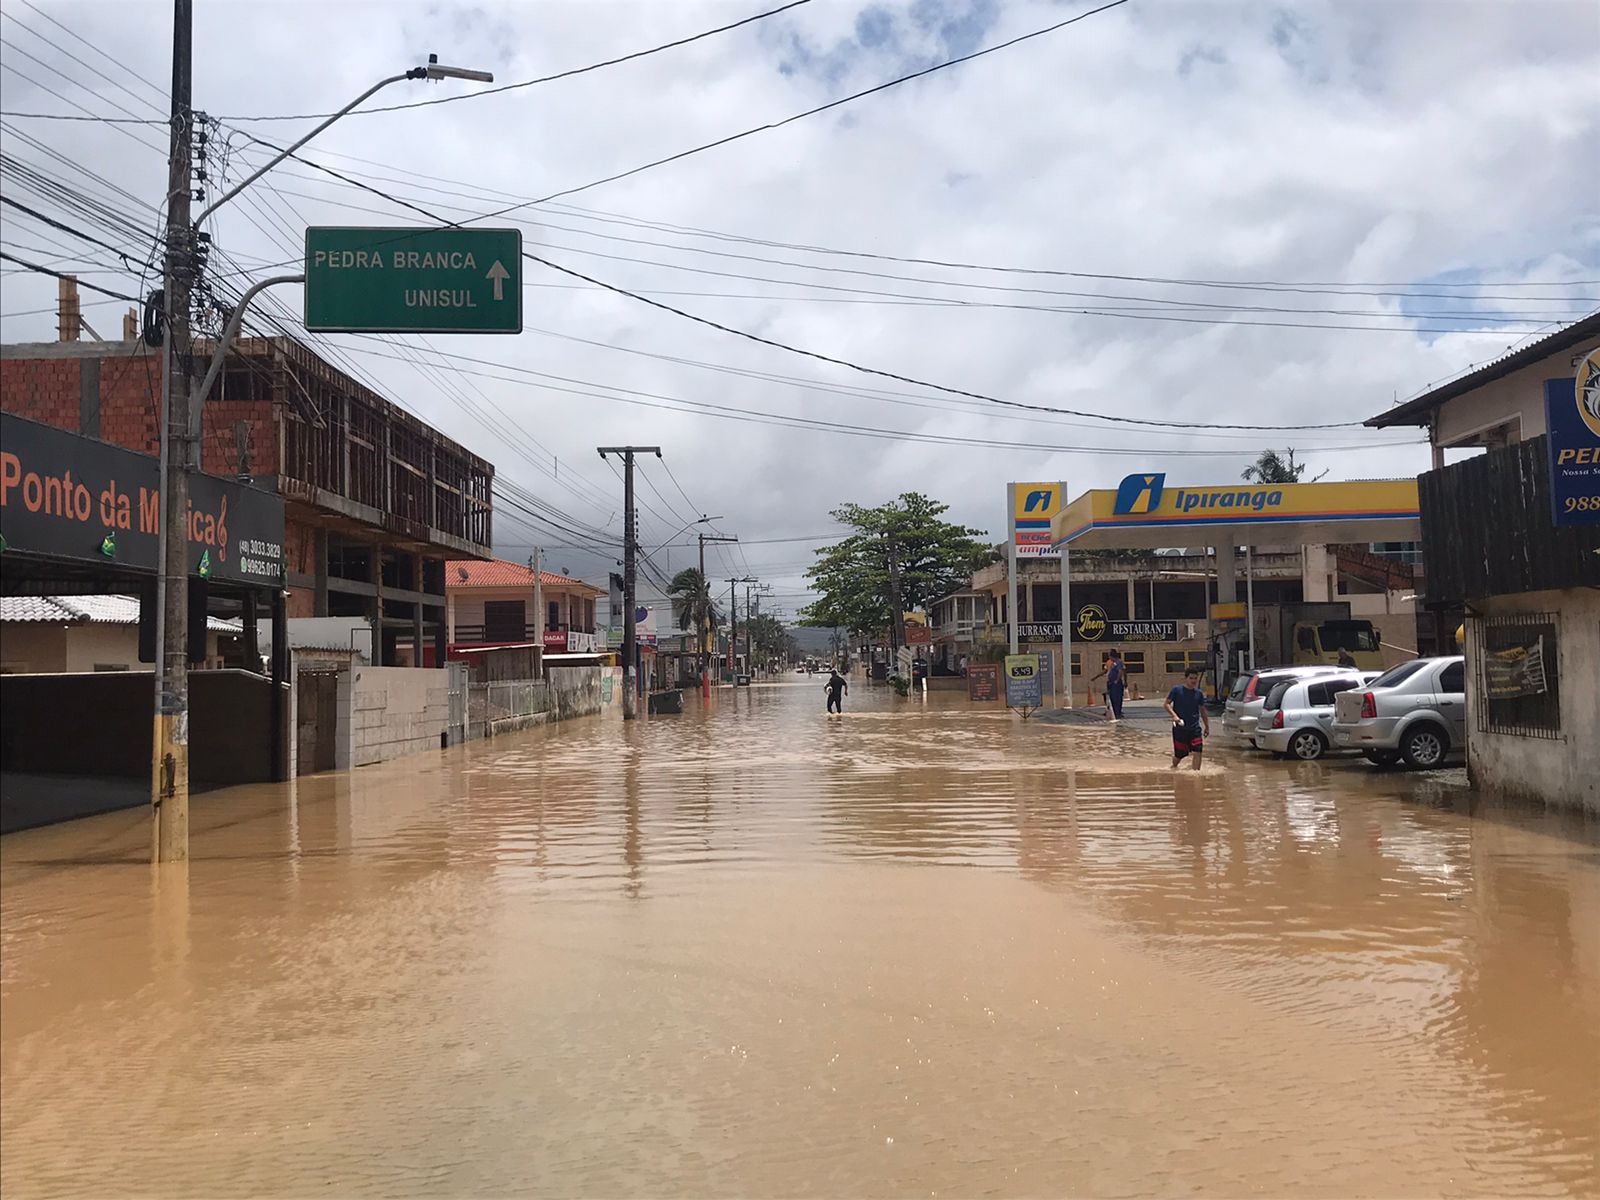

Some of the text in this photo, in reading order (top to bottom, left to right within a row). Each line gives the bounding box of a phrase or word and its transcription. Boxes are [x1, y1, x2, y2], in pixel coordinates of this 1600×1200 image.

[314, 250, 477, 270] PEDRA BRANCA
[404, 289, 477, 308] UNISUL
[0, 451, 216, 546] Ponto da Mica
[1175, 490, 1282, 513] Ipiranga
[1018, 624, 1064, 636] HURRASCAR
[1112, 623, 1173, 635] RESTAURANTE
[1013, 667, 1031, 676] 5.49
